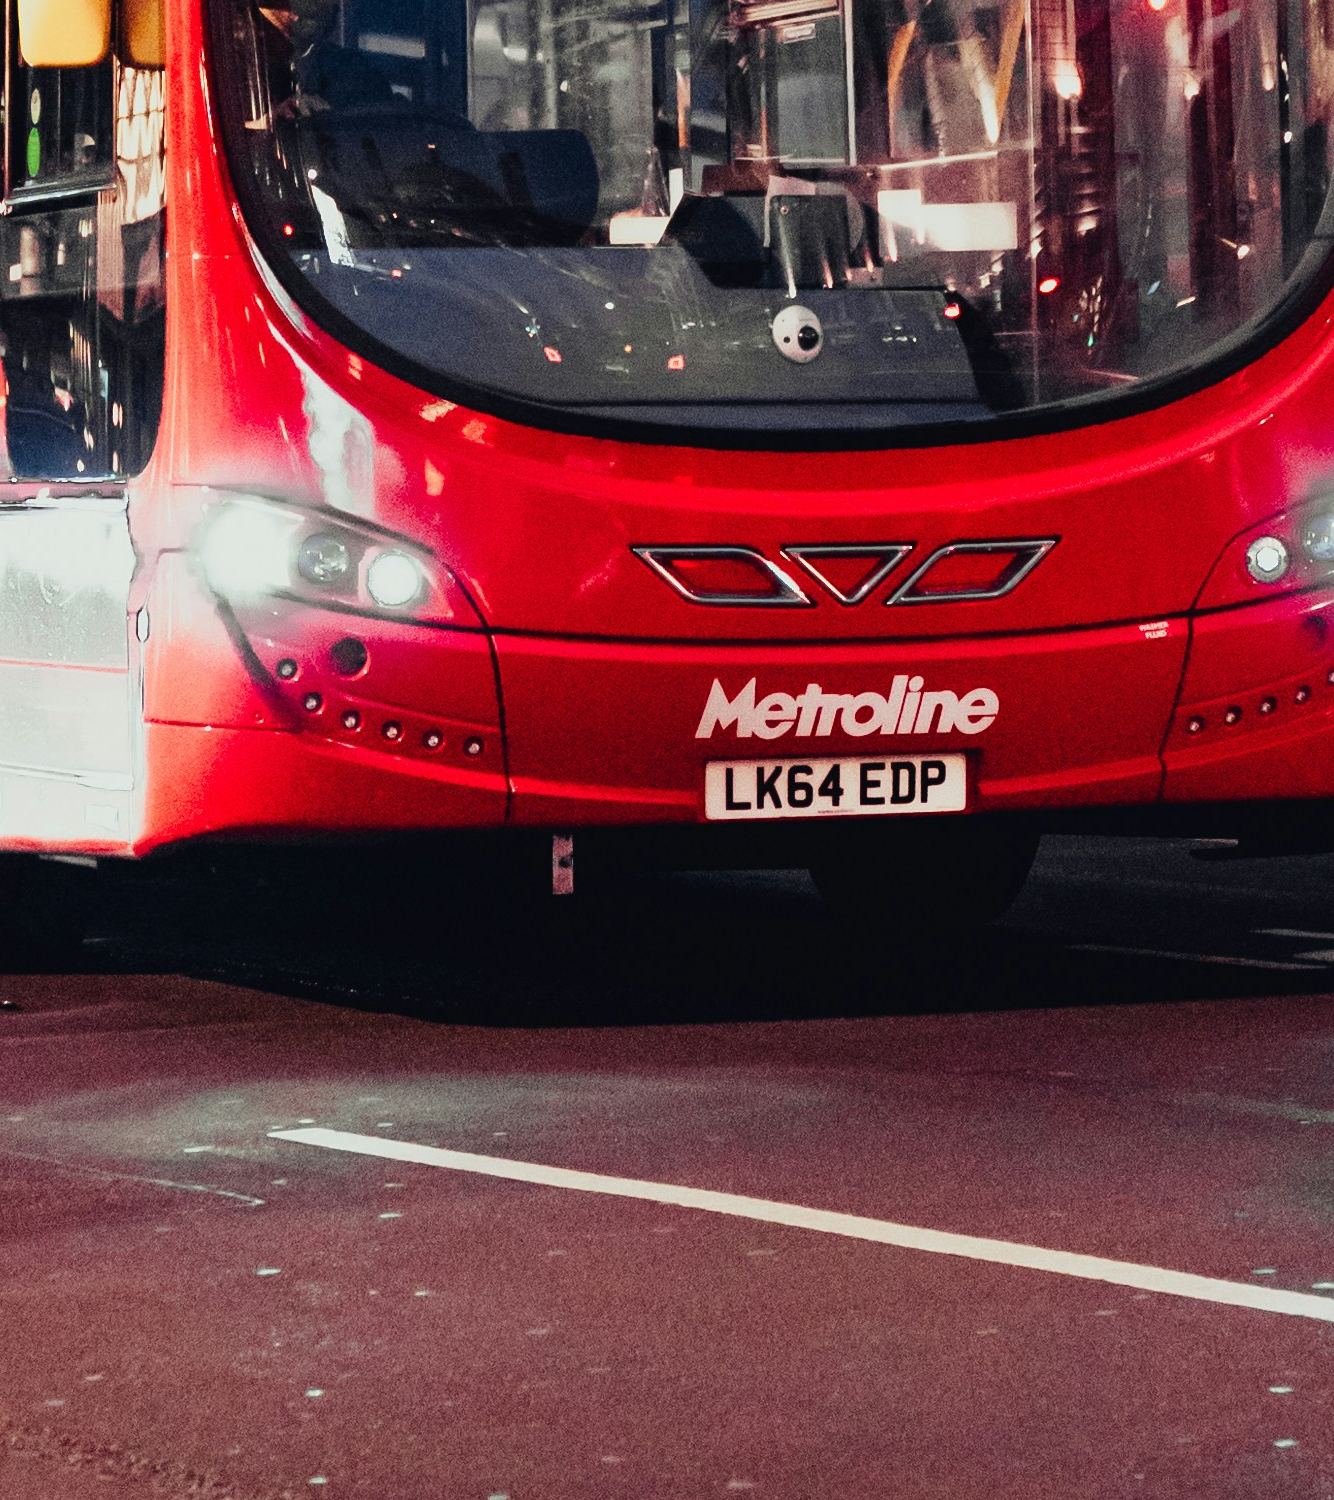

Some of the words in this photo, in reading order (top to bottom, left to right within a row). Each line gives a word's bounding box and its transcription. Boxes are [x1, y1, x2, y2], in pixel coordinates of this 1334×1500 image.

[695, 674, 999, 739] Metroline
[724, 764, 844, 811] LK64
[859, 760, 947, 806] EDP
